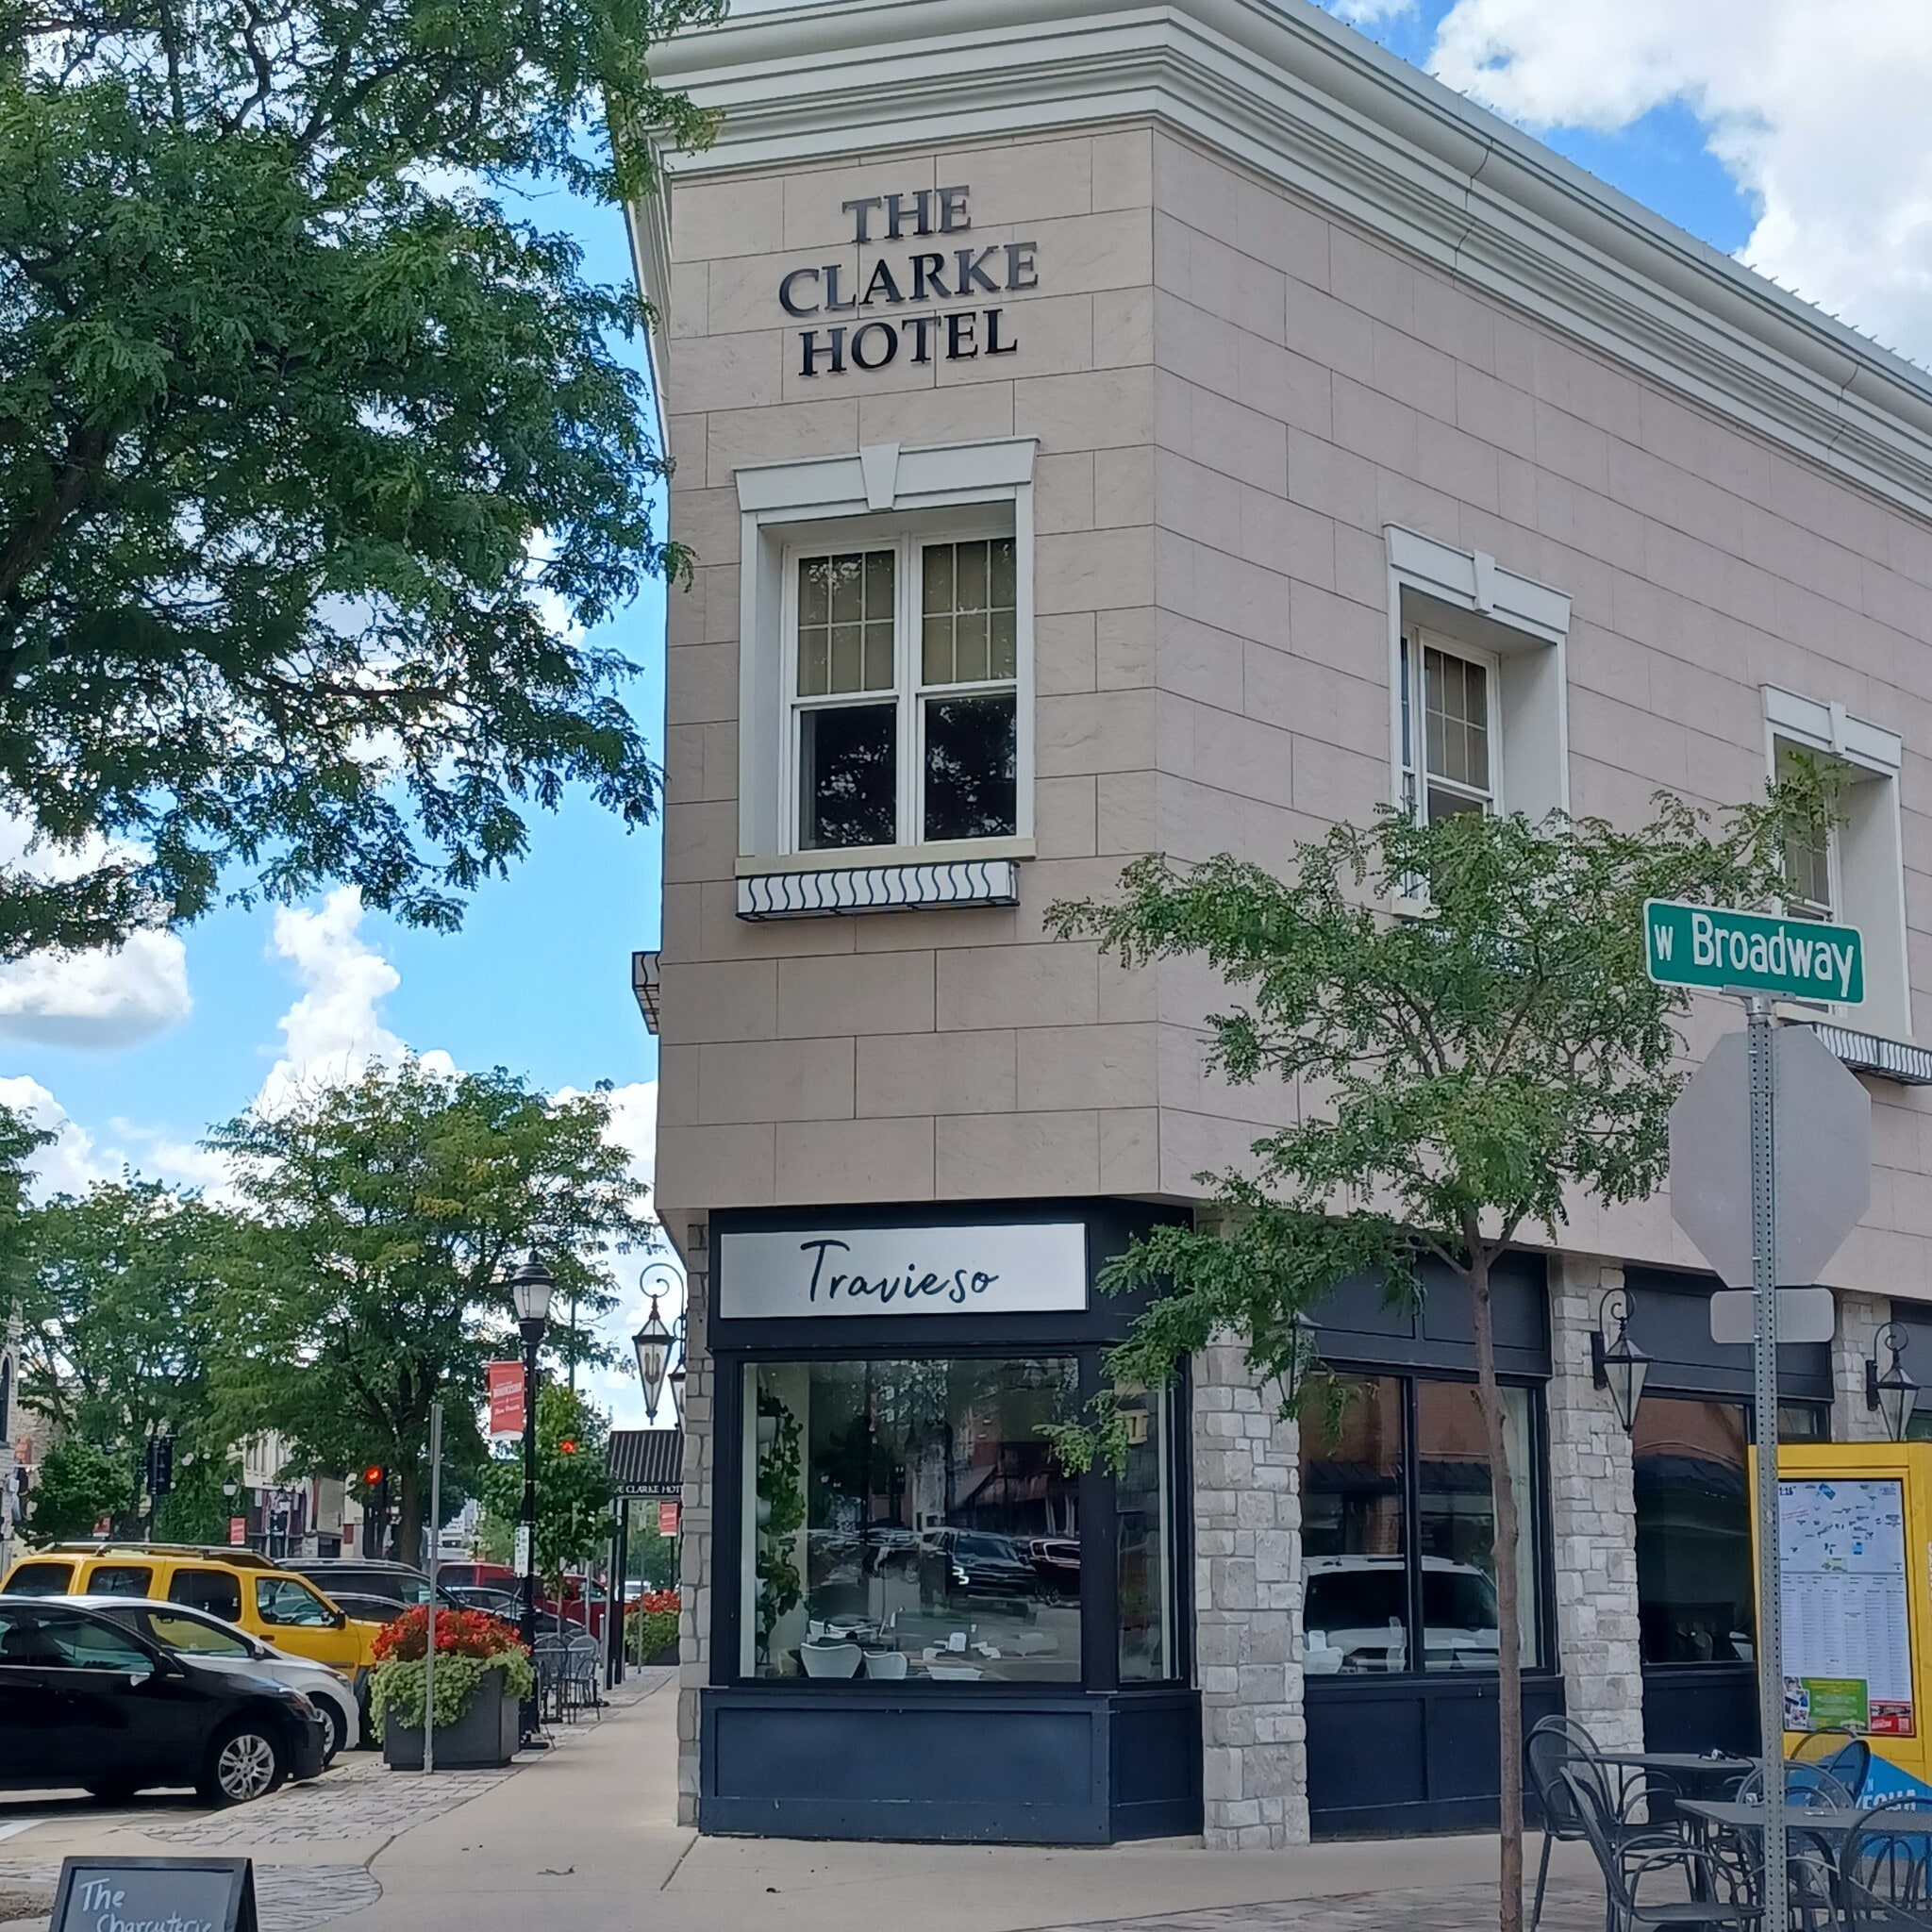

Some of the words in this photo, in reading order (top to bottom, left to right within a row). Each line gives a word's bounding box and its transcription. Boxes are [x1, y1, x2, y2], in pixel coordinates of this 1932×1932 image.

[842, 185, 971, 243] THE
[779, 242, 1039, 317] CLARKE
[798, 308, 1018, 376] HOTEL
[1654, 924, 1674, 961] W
[1691, 912, 1855, 998] Broadway
[800, 1239, 1000, 1304] Travieso
[625, 1485, 659, 1493] CLARKE
[661, 1485, 681, 1493] HOT
[79, 1877, 125, 1912] The
